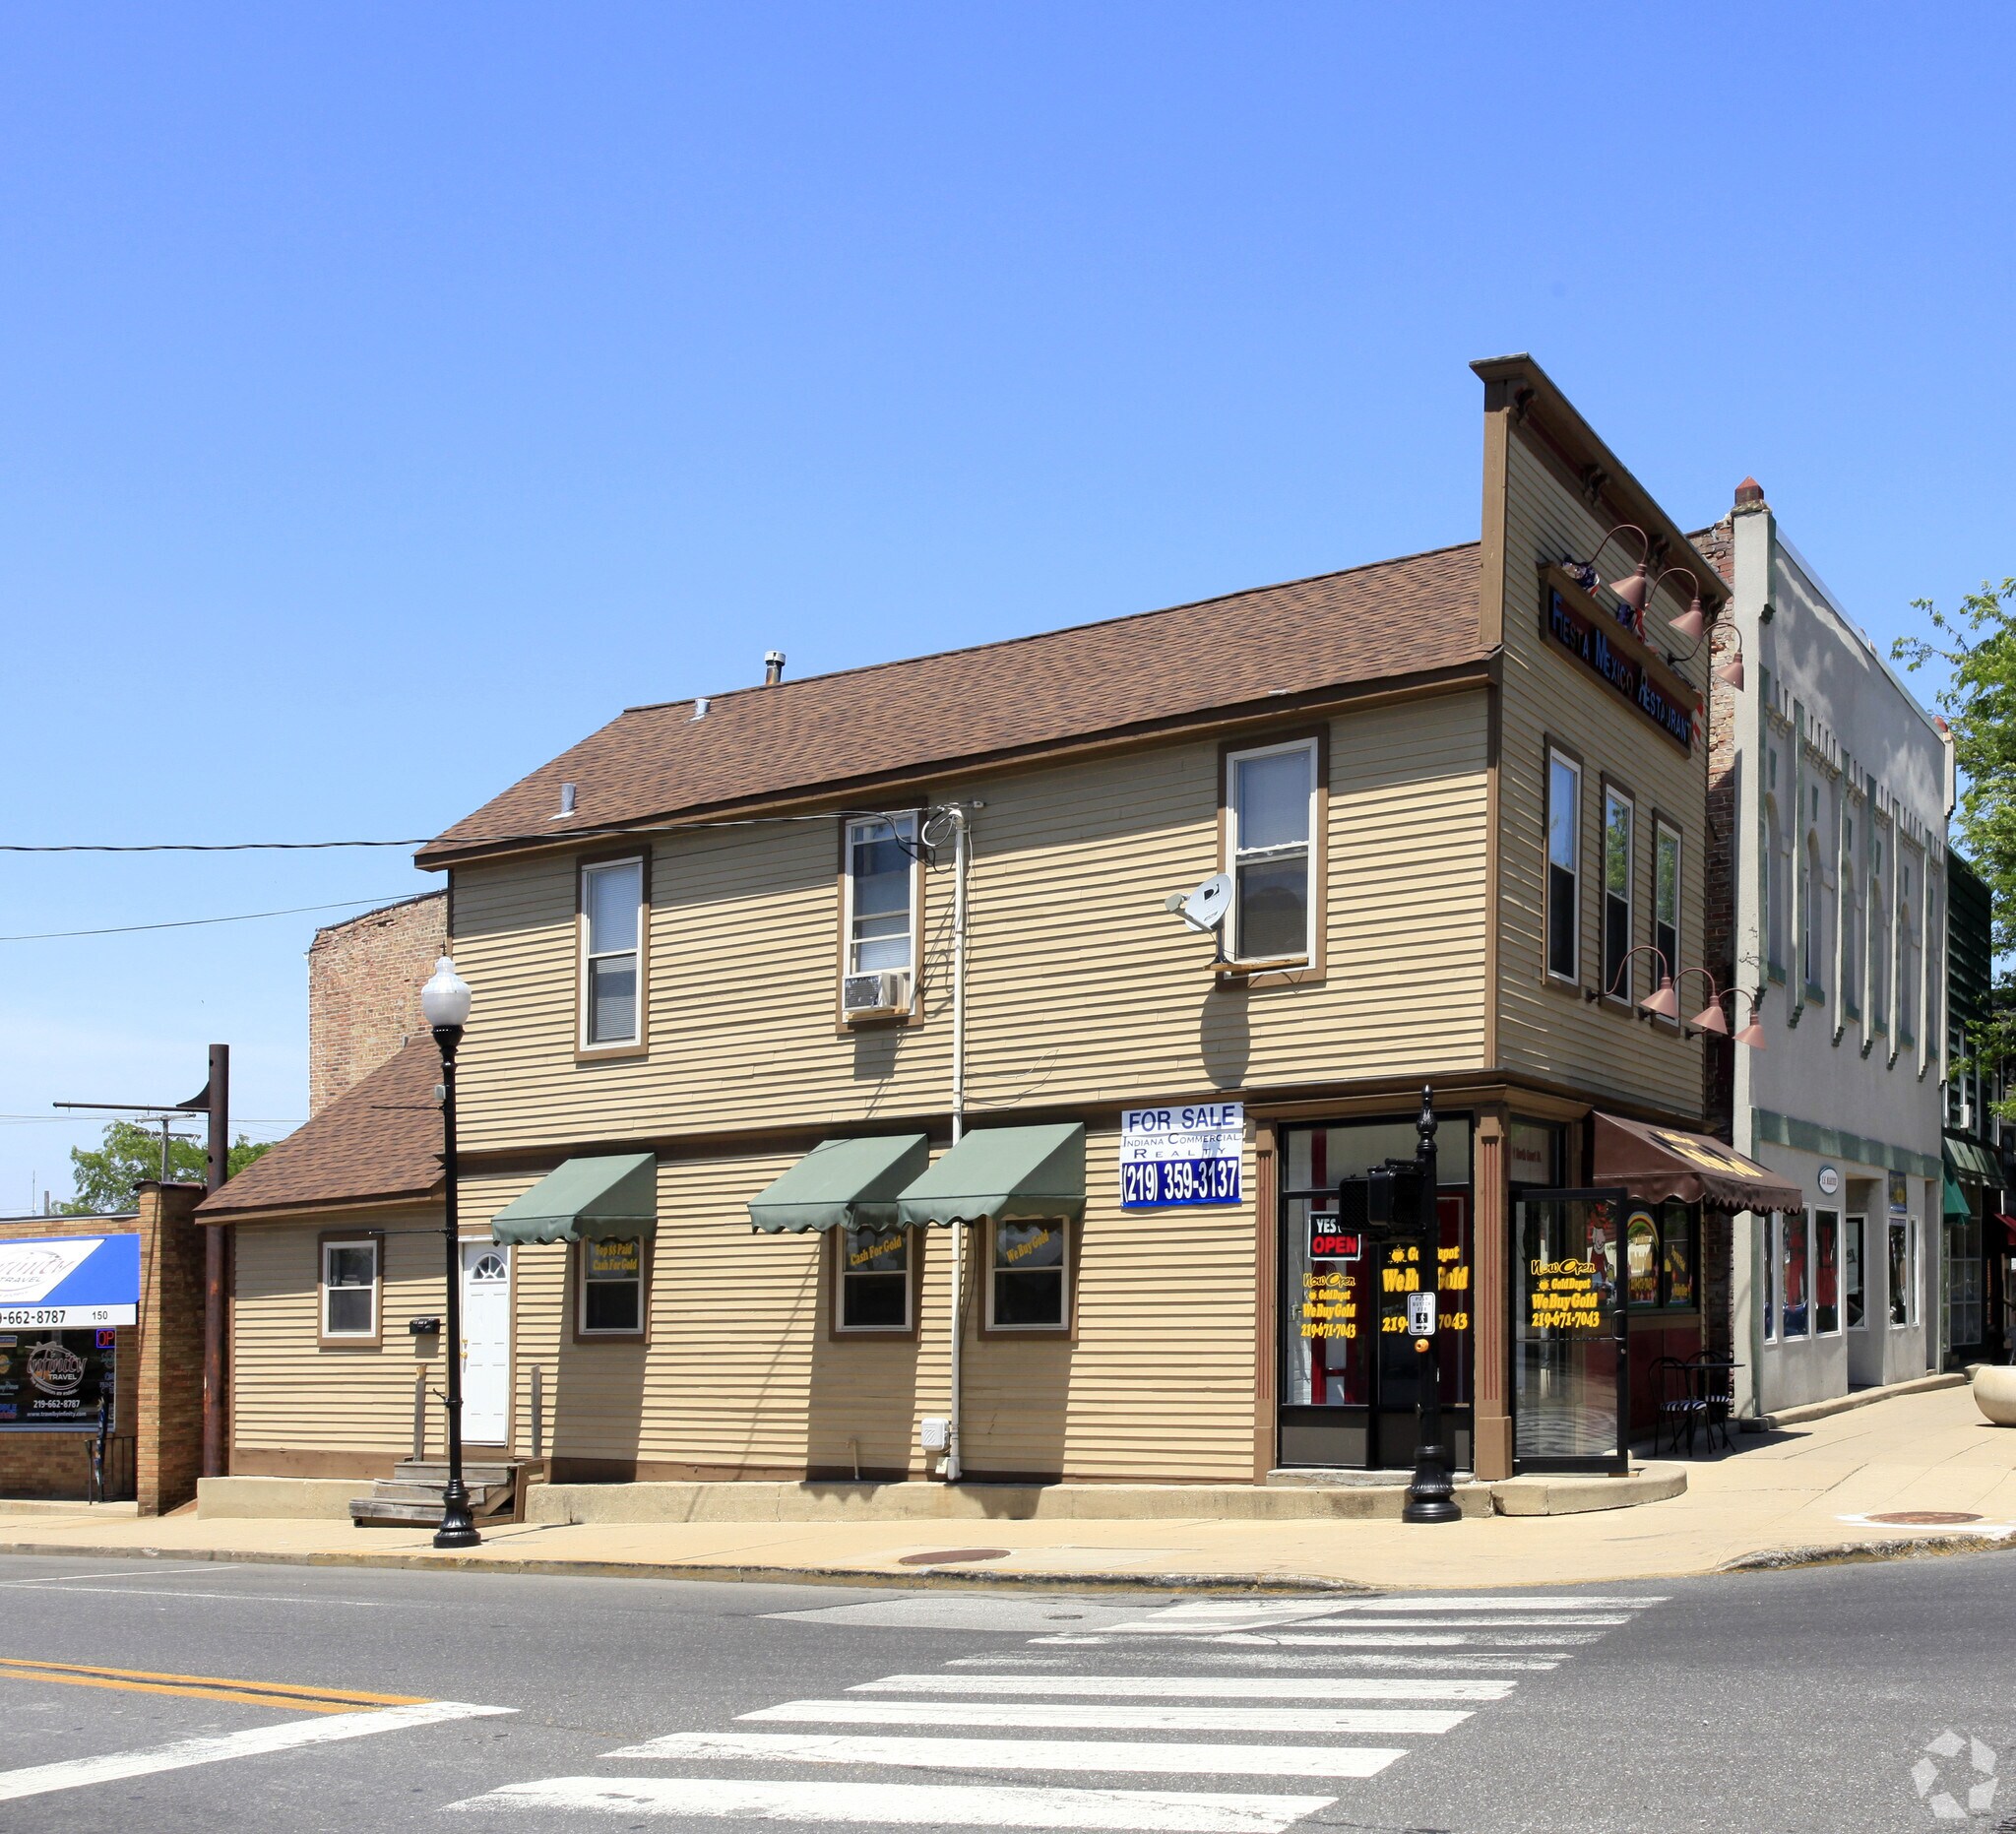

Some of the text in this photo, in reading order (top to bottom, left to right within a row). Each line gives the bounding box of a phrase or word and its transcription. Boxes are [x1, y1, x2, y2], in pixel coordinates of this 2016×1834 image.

[1129, 1106, 1235, 1132] FOR SALE
[1123, 1133, 1241, 1148] INDIANA COMMERCIAL
[1134, 1148, 1227, 1160] REALTY
[1123, 1161, 1238, 1202] (219) 359-3137
[1316, 1218, 1337, 1233] YES
[850, 1234, 902, 1266] Cash For Gold
[1017, 1243, 1033, 1258] Buy
[1032, 1229, 1049, 1248] Gold
[1312, 1235, 1358, 1254] OPEN
[1437, 1245, 1460, 1262] epot
[621, 1258, 638, 1270] Gold
[1531, 1258, 1597, 1276] Now Open
[1303, 1272, 1355, 1288] Now Open
[1571, 1293, 1599, 1308] Gold
[93, 1310, 108, 1321] 150
[1334, 1303, 1356, 1317] Gold
[1531, 1310, 1601, 1329] 219-671-7043
[98, 1331, 115, 1346] OP
[1300, 1322, 1356, 1339] 219-671-7043
[32, 1399, 81, 1409] 219-662-8787
